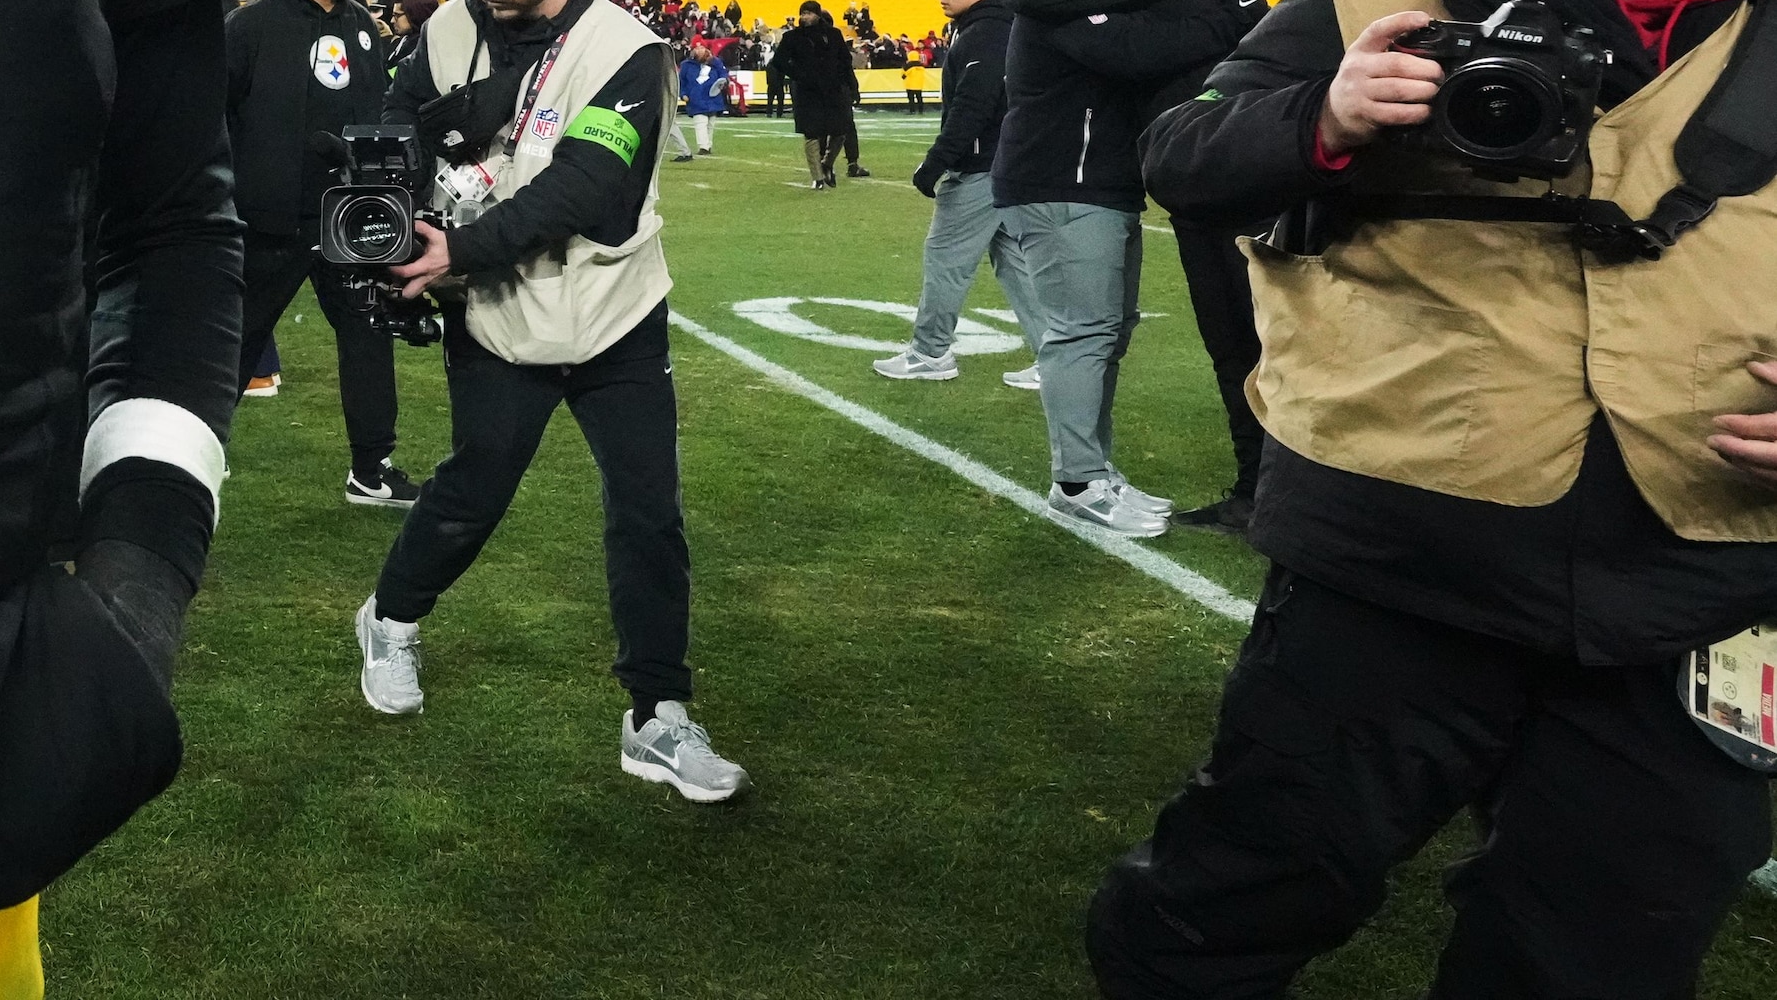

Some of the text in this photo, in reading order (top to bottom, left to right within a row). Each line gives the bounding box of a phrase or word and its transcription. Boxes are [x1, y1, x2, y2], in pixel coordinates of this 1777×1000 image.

[1497, 29, 1544, 44] Nikon
[532, 60, 550, 90] TEXANS
[510, 109, 527, 140] TEXANS
[535, 120, 557, 138] NFL
[583, 126, 614, 142] CARD
[1761, 692, 1772, 718] MEDIA
